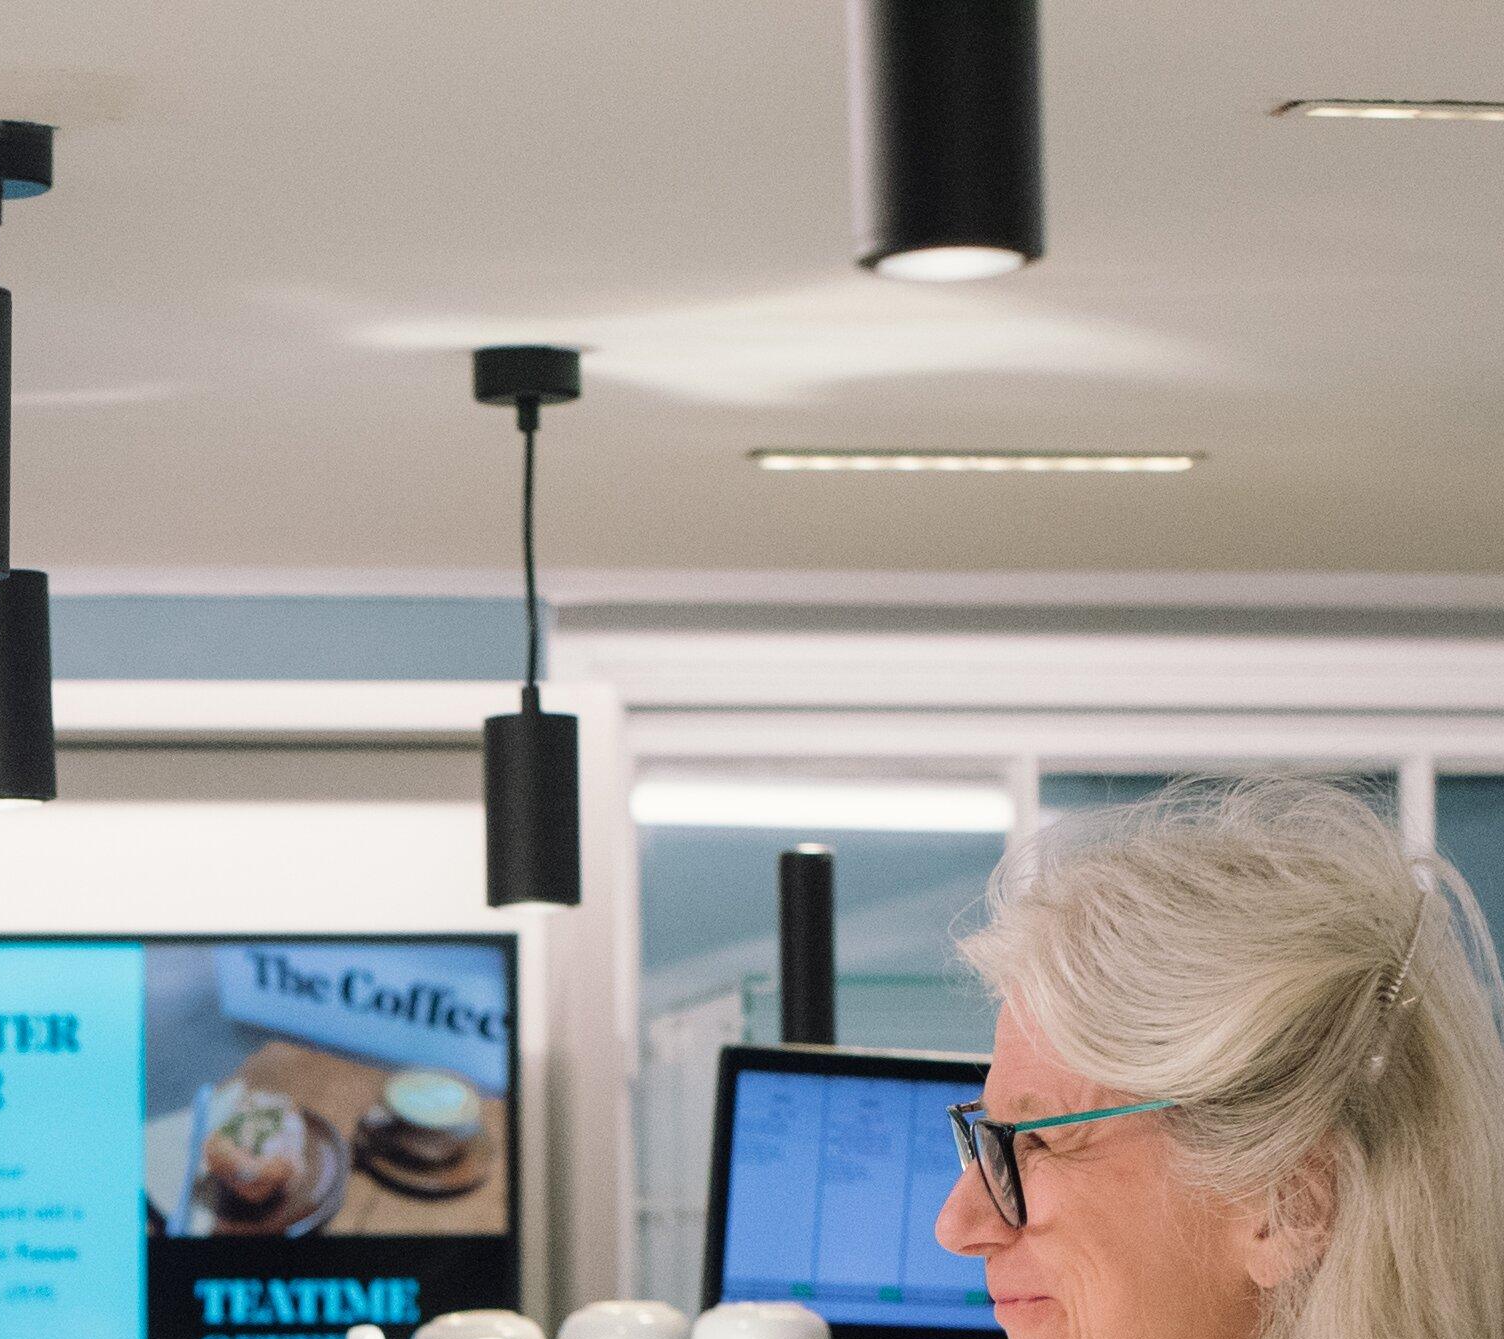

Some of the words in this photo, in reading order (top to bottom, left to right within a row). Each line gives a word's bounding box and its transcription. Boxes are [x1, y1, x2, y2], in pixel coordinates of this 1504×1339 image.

[246, 948, 328, 1002] The
[338, 968, 507, 1046] Coffee
[194, 1278, 421, 1325] TEATIME
